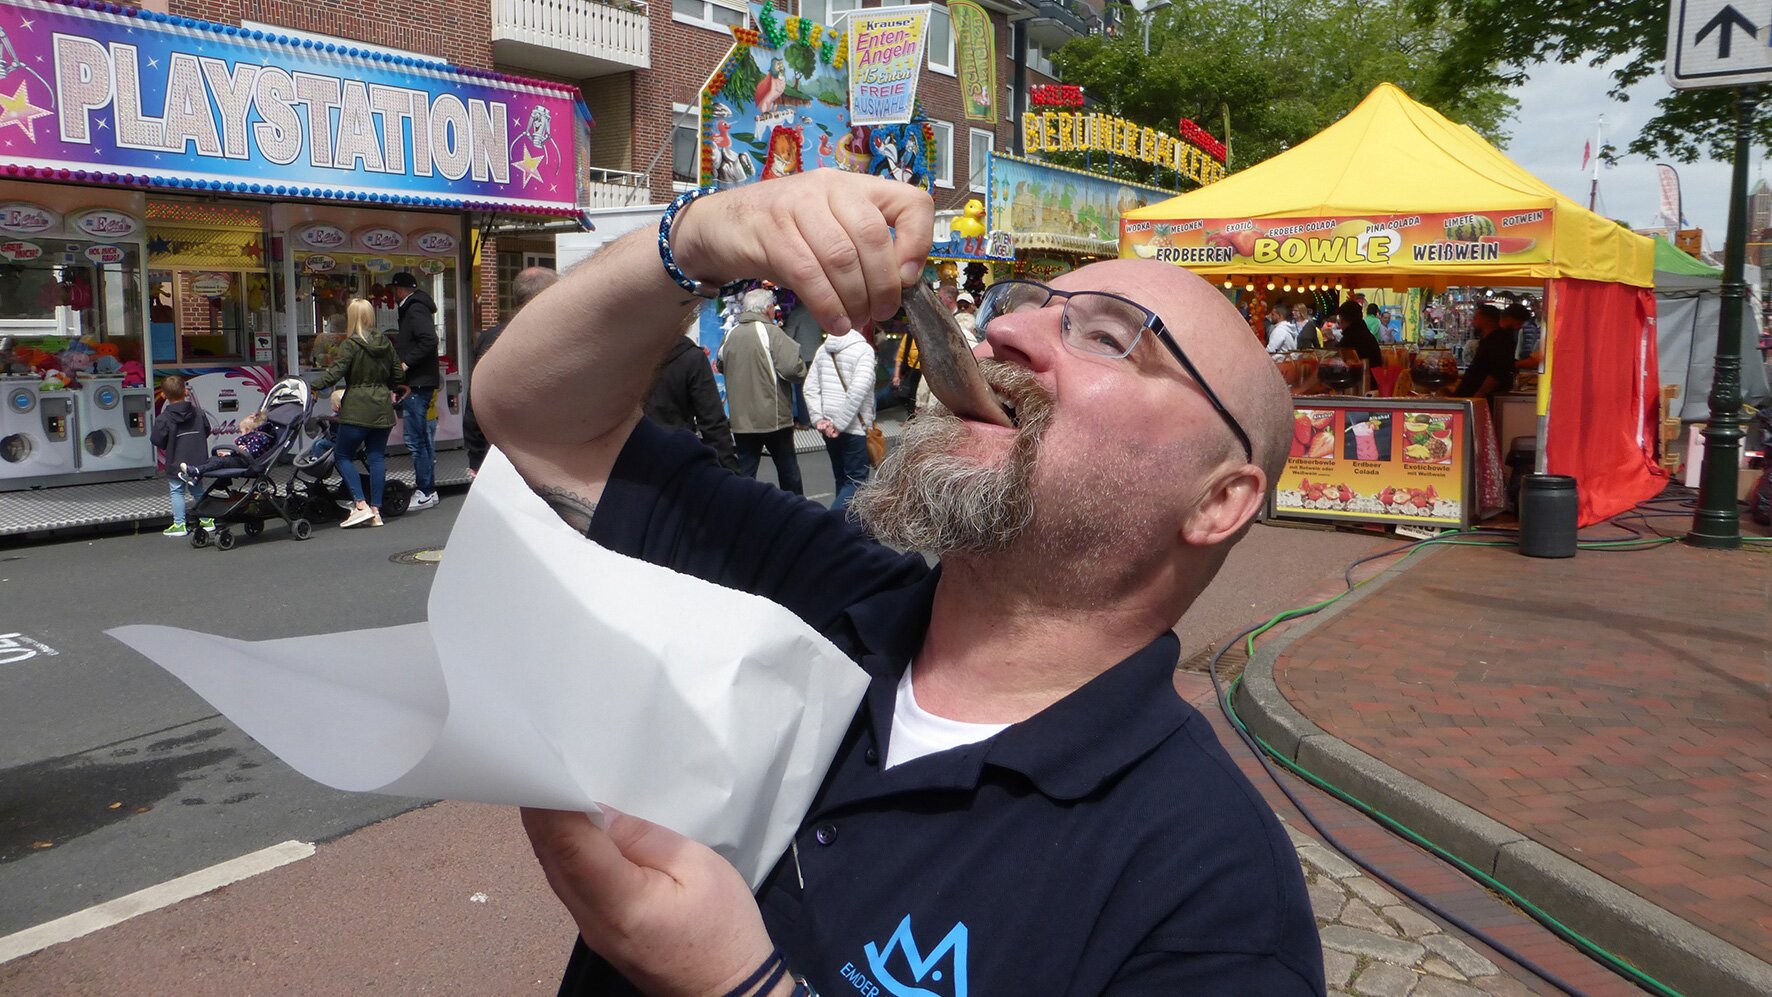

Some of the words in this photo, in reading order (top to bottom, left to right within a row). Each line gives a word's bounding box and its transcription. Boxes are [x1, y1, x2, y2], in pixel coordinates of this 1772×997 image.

[856, 29, 910, 51] Enten-
[859, 40, 916, 68] Angeln
[864, 68, 878, 83] 15
[860, 83, 906, 97] FREIE
[52, 32, 511, 184] PLAYSTATION
[854, 97, 906, 117] AUSWAHL
[1021, 112, 1139, 159] BERLINER
[1170, 220, 1204, 233] MELONEN
[1226, 221, 1252, 232] EXOTIC
[1387, 217, 1420, 230] COLADA
[1444, 215, 1475, 228] LIMETE
[1502, 211, 1544, 227] ROTWEIN
[1126, 222, 1150, 233] WODKA
[1269, 225, 1304, 237] ERDBEER
[1305, 220, 1336, 232] COLADA
[1156, 246, 1233, 263] ERDBEEREN
[1253, 236, 1391, 264] BOWLE
[1288, 458, 1336, 466] Erdbeerbowle
[1403, 464, 1450, 472] Exoticbowle
[1354, 468, 1380, 476] Colada
[840, 962, 880, 997] EMDER
